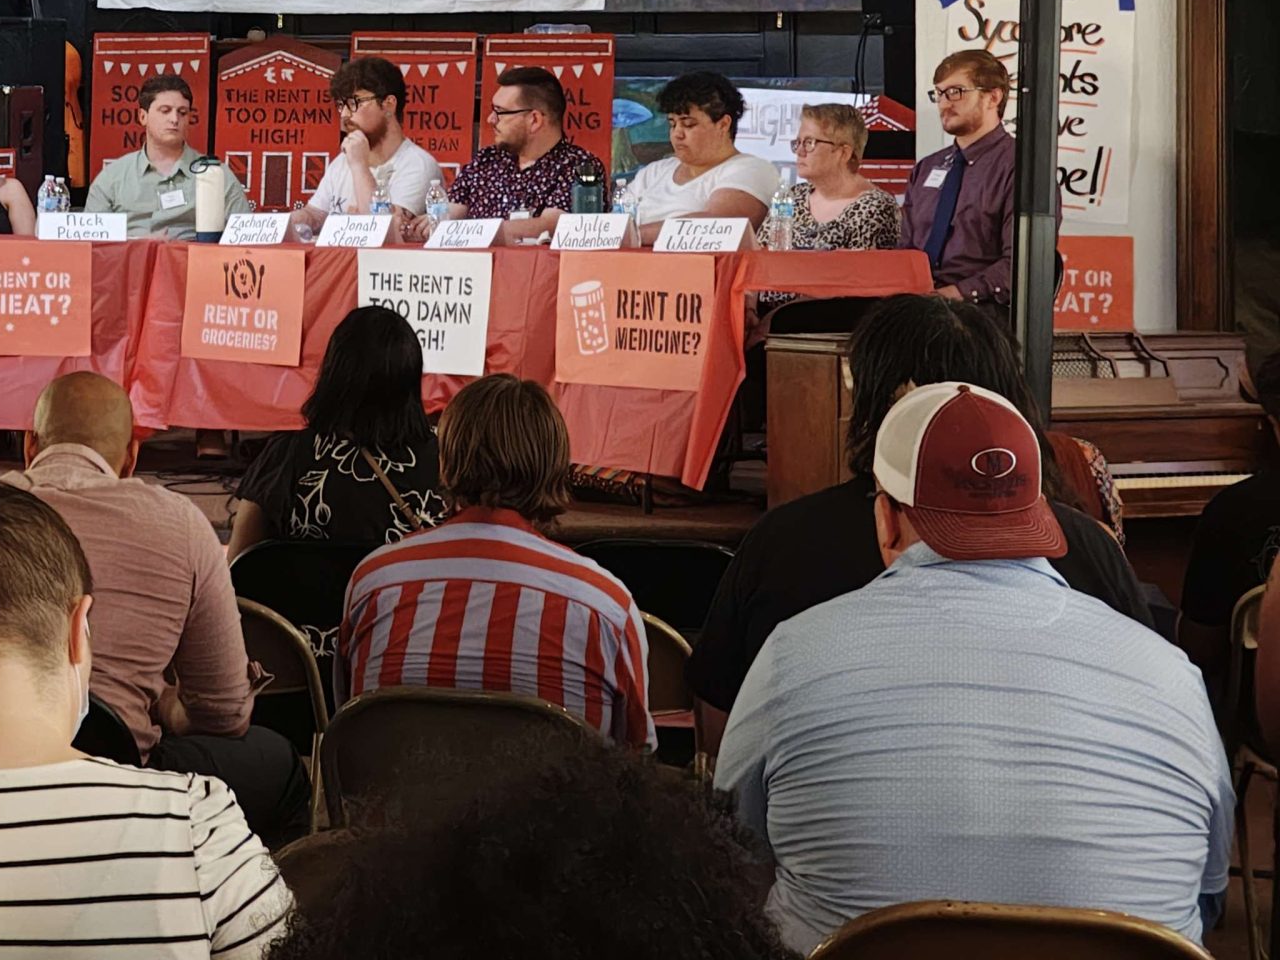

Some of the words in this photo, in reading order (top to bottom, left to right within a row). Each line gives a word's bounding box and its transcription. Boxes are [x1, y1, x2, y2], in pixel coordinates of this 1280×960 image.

[224, 88, 259, 103] THE
[265, 88, 311, 103] RENT
[317, 89, 331, 103] IS
[405, 85, 440, 104] ENT
[224, 107, 267, 124] TOO
[274, 107, 332, 124] DAMN
[406, 111, 462, 130] TROL
[250, 128, 305, 145] HIGH!
[428, 137, 459, 152] BAN
[340, 215, 377, 232] Jonah
[446, 220, 484, 236] Olivia
[574, 215, 610, 233] Julie
[57, 226, 109, 241] Pigeon
[327, 230, 369, 247] Stone
[665, 235, 723, 251] Walters
[45, 272, 71, 289] OR
[369, 272, 403, 292] THE
[409, 274, 453, 295] RENT
[459, 277, 473, 296] IS
[1084, 269, 1113, 287] OR
[417, 301, 472, 324] DAMN
[616, 289, 669, 322] RENT
[675, 293, 702, 324] OR
[204, 303, 251, 329] RENT
[254, 309, 279, 330] OR
[201, 328, 278, 351] GROCERIES?
[415, 329, 445, 351] GH!
[615, 327, 701, 356] MEDICINE?
